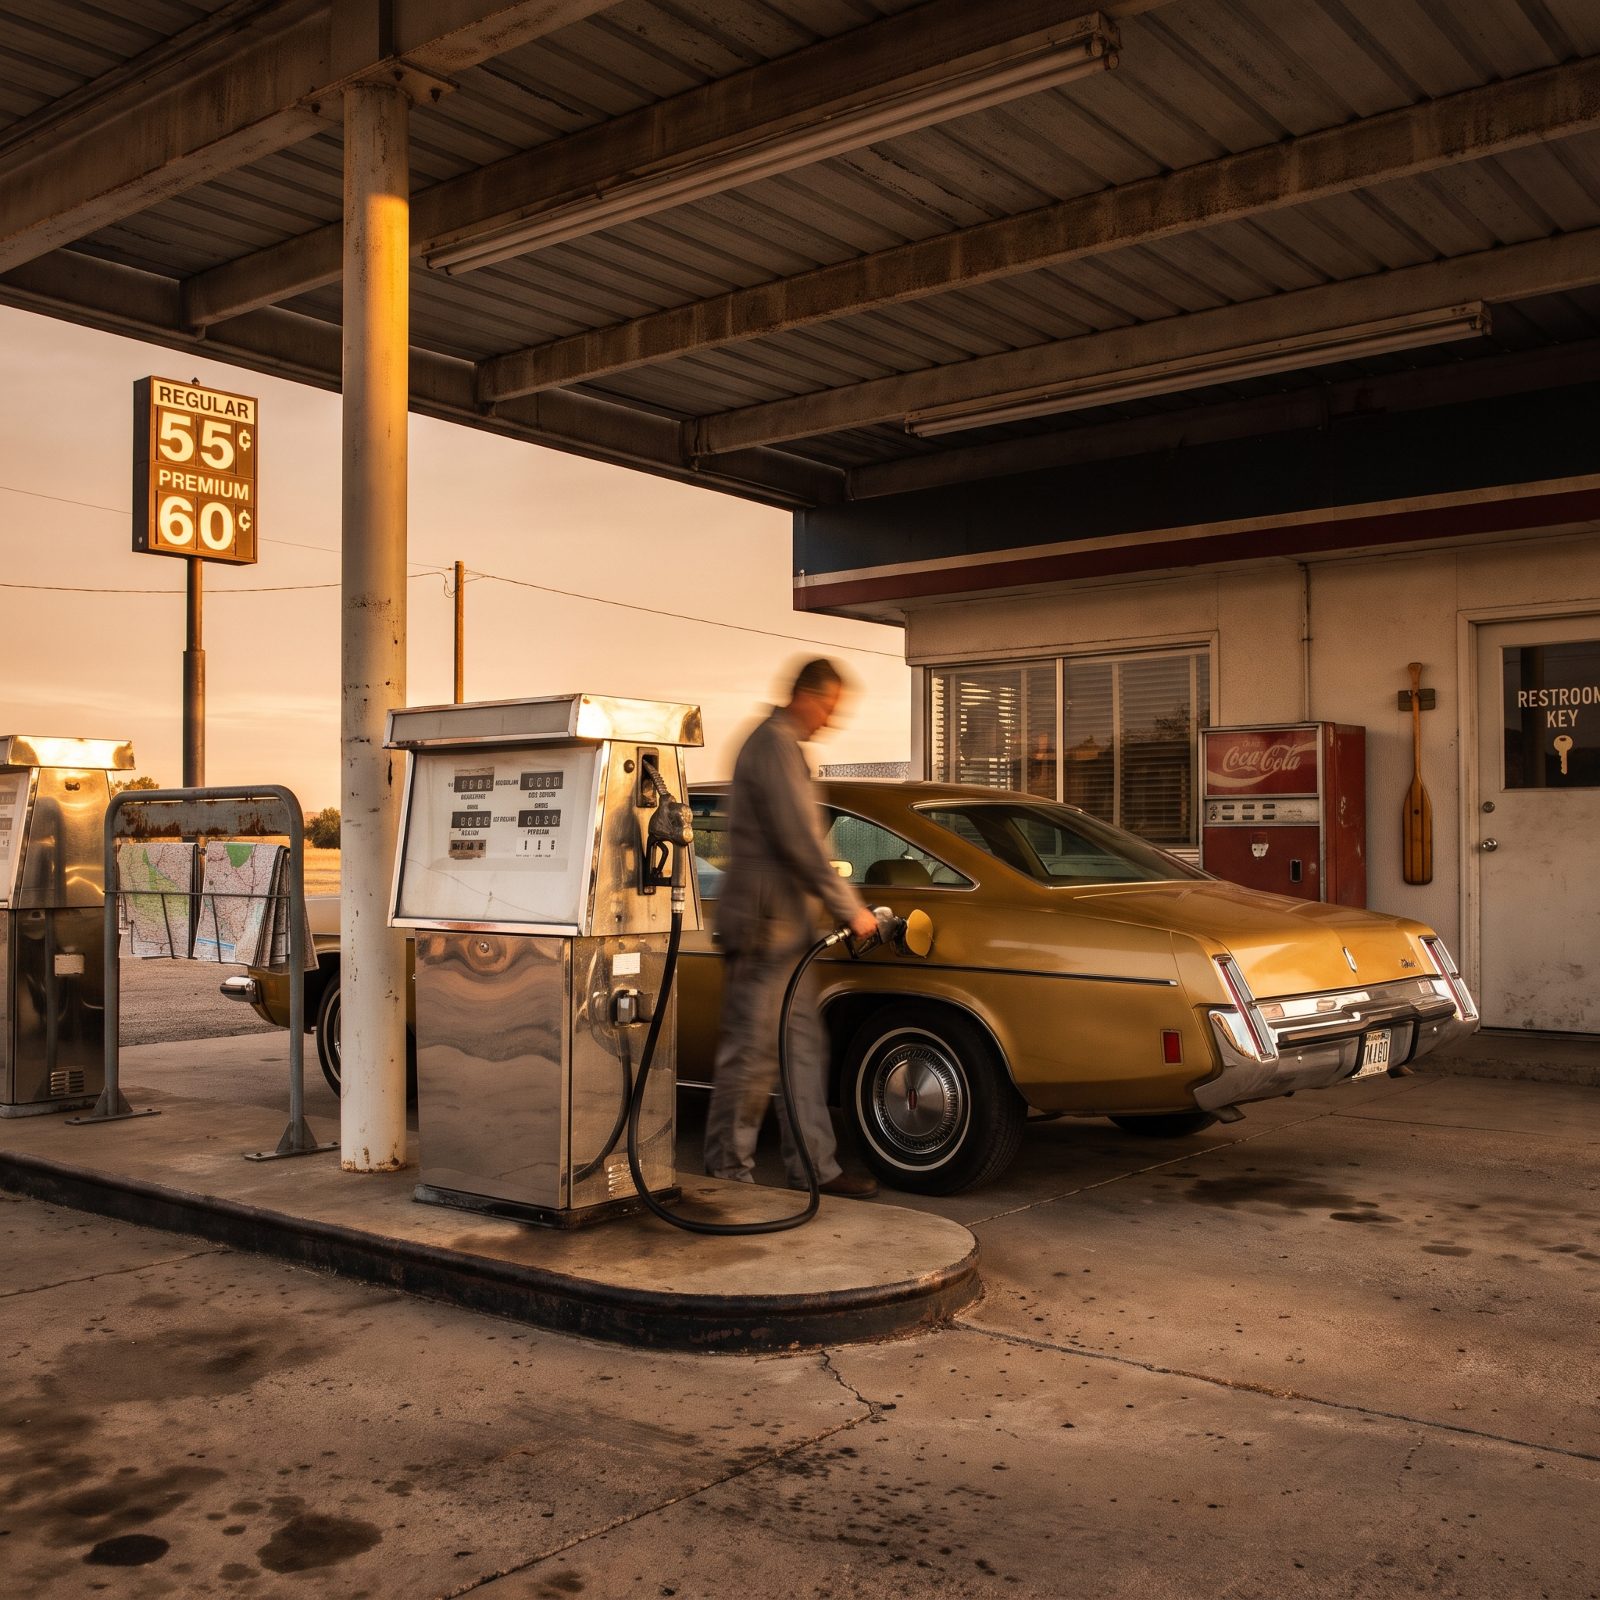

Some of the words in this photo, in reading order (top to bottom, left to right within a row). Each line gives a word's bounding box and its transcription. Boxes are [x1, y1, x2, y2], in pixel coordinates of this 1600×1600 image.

[159, 385, 249, 419] REGULAR
[159, 469, 249, 501] PREMIUM
[1546, 709, 1579, 728] KEY
